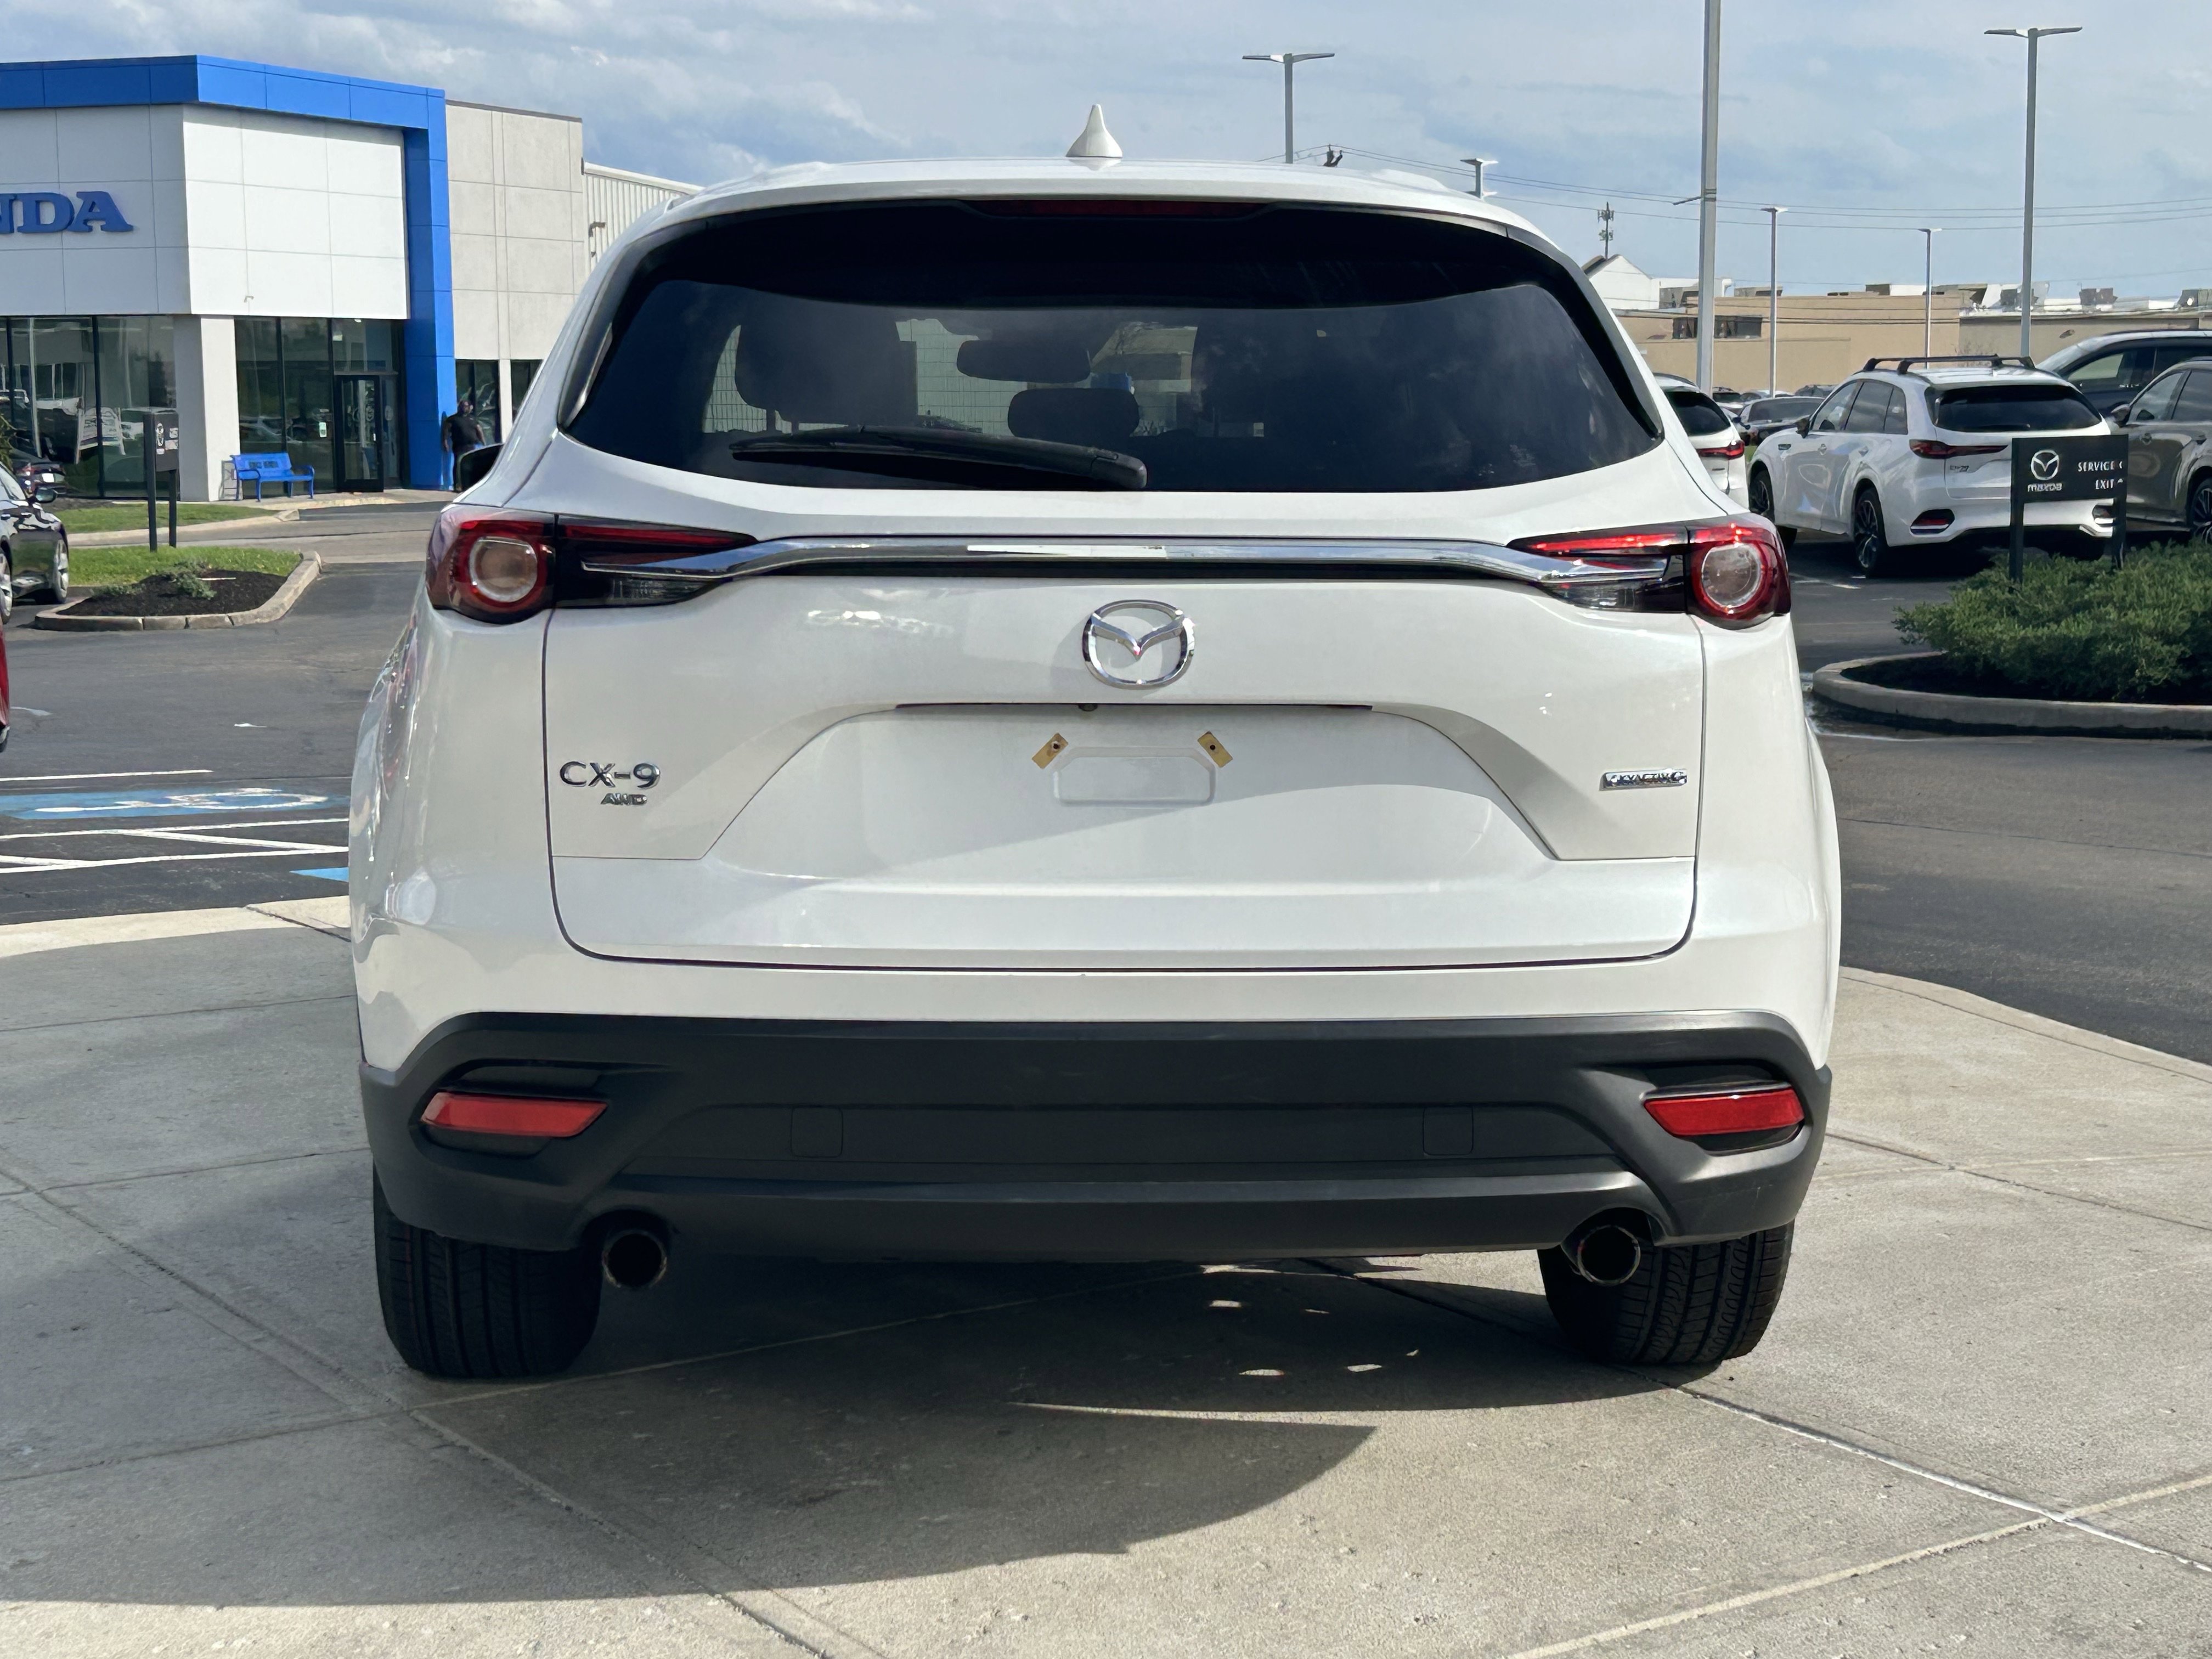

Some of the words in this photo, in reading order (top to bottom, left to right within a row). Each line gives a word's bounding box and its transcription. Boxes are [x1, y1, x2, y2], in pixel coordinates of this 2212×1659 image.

[2078, 460, 2115, 472] SERVICE
[2095, 478, 2114, 489] EXIT
[560, 761, 661, 789] CX-9
